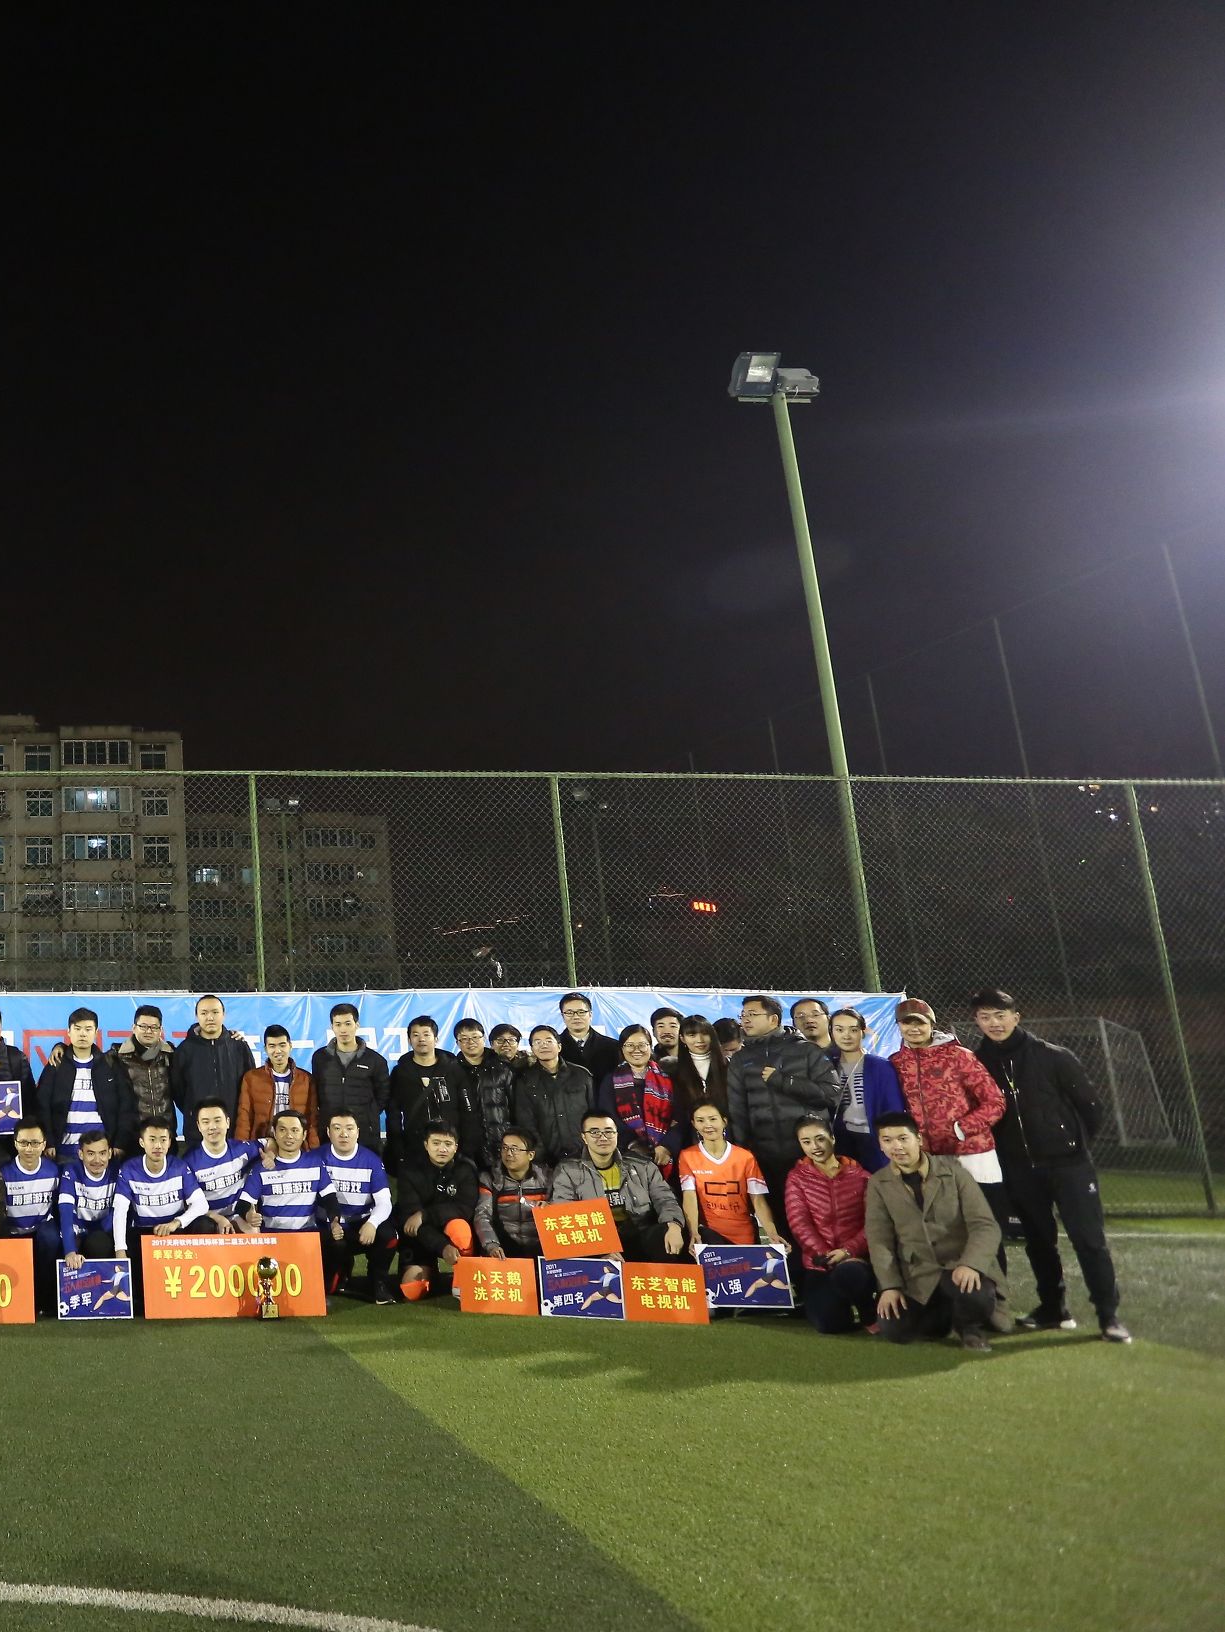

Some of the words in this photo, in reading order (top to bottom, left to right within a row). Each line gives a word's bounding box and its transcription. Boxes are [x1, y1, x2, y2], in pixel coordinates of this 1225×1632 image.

[543, 1211, 606, 1231] 东芝智能
[555, 1228, 603, 1246] 电视机
[473, 1270, 522, 1286] 小天鹅
[630, 1275, 697, 1293] 东芝智能
[473, 1286, 523, 1302] 洗衣机
[716, 1278, 743, 1297] 八强
[69, 1291, 92, 1310] 季军
[553, 1291, 584, 1308] 第四名
[640, 1293, 690, 1310] 电视机
